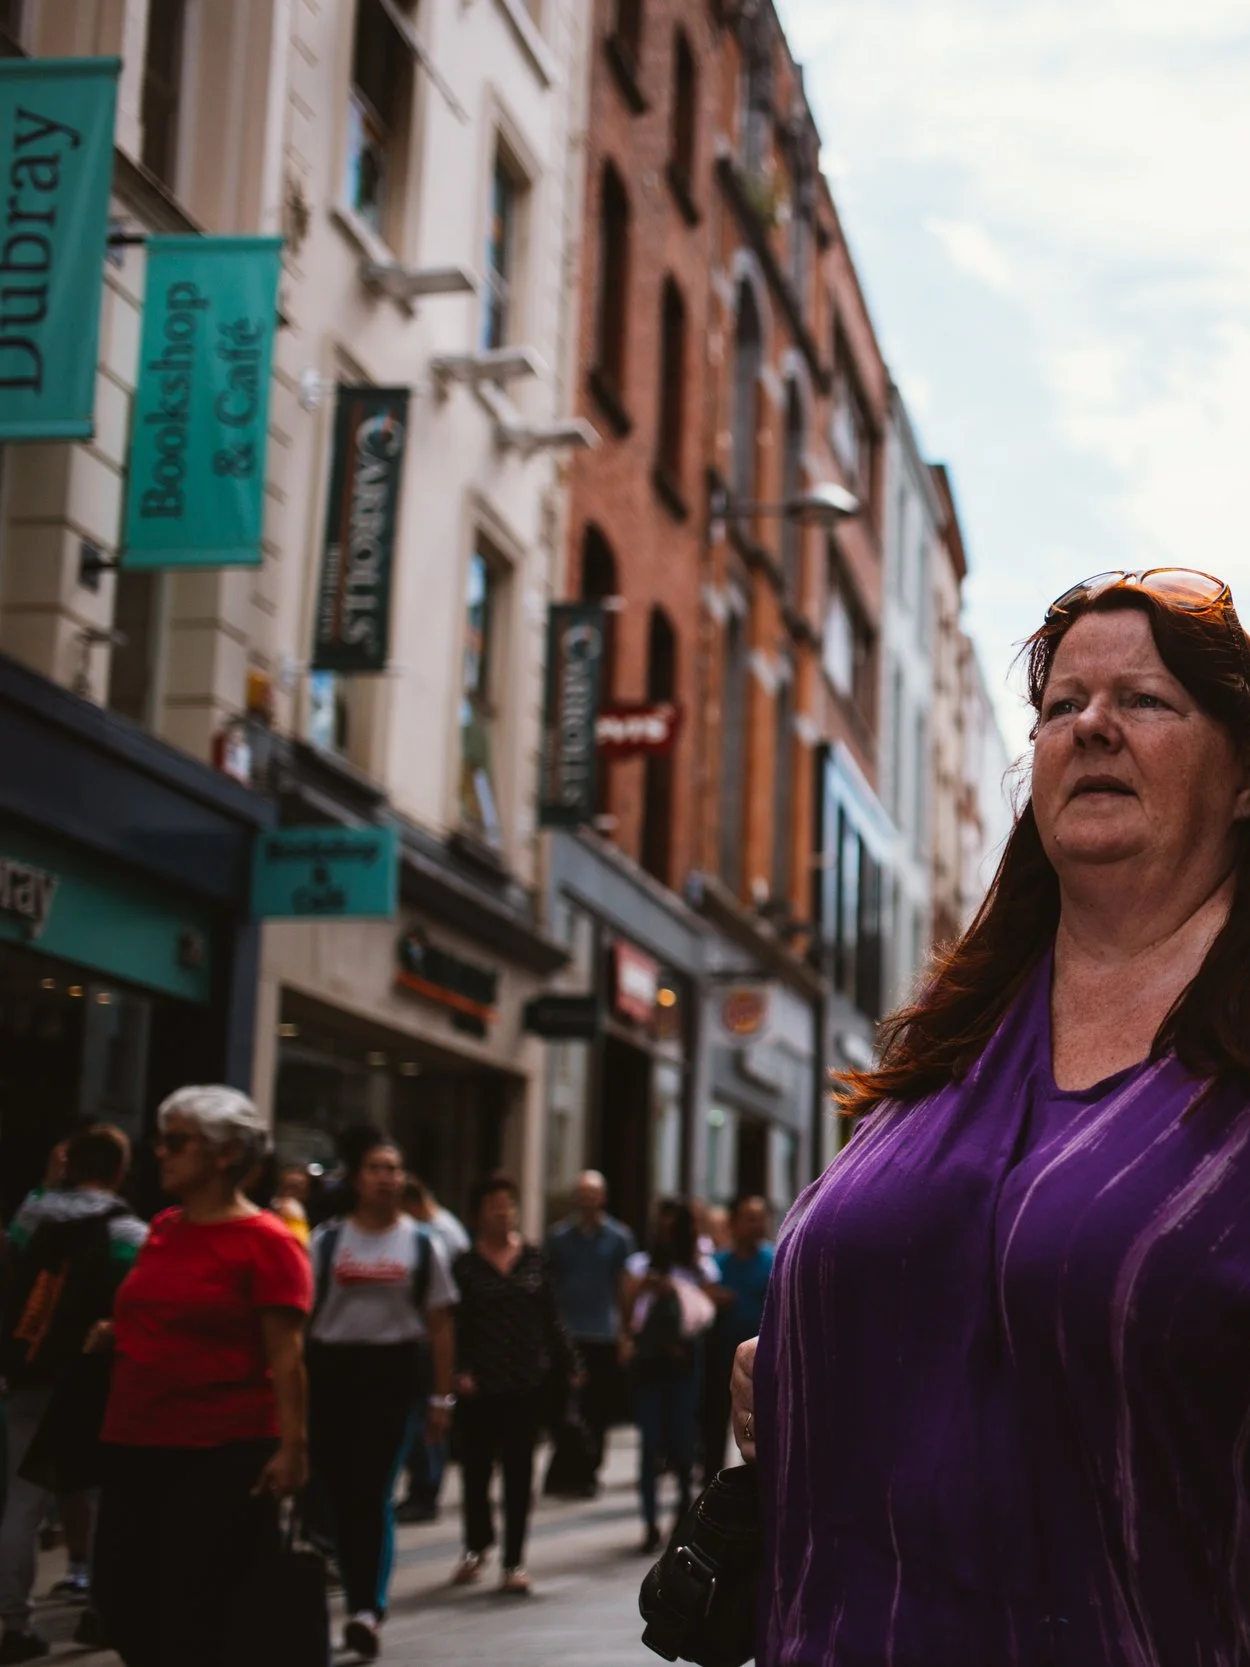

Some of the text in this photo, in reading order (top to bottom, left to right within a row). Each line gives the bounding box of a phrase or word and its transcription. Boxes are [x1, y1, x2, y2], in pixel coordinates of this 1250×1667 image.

[0, 104, 81, 396] Dubray
[139, 281, 210, 521] Bookshop
[210, 316, 264, 479] & Café
